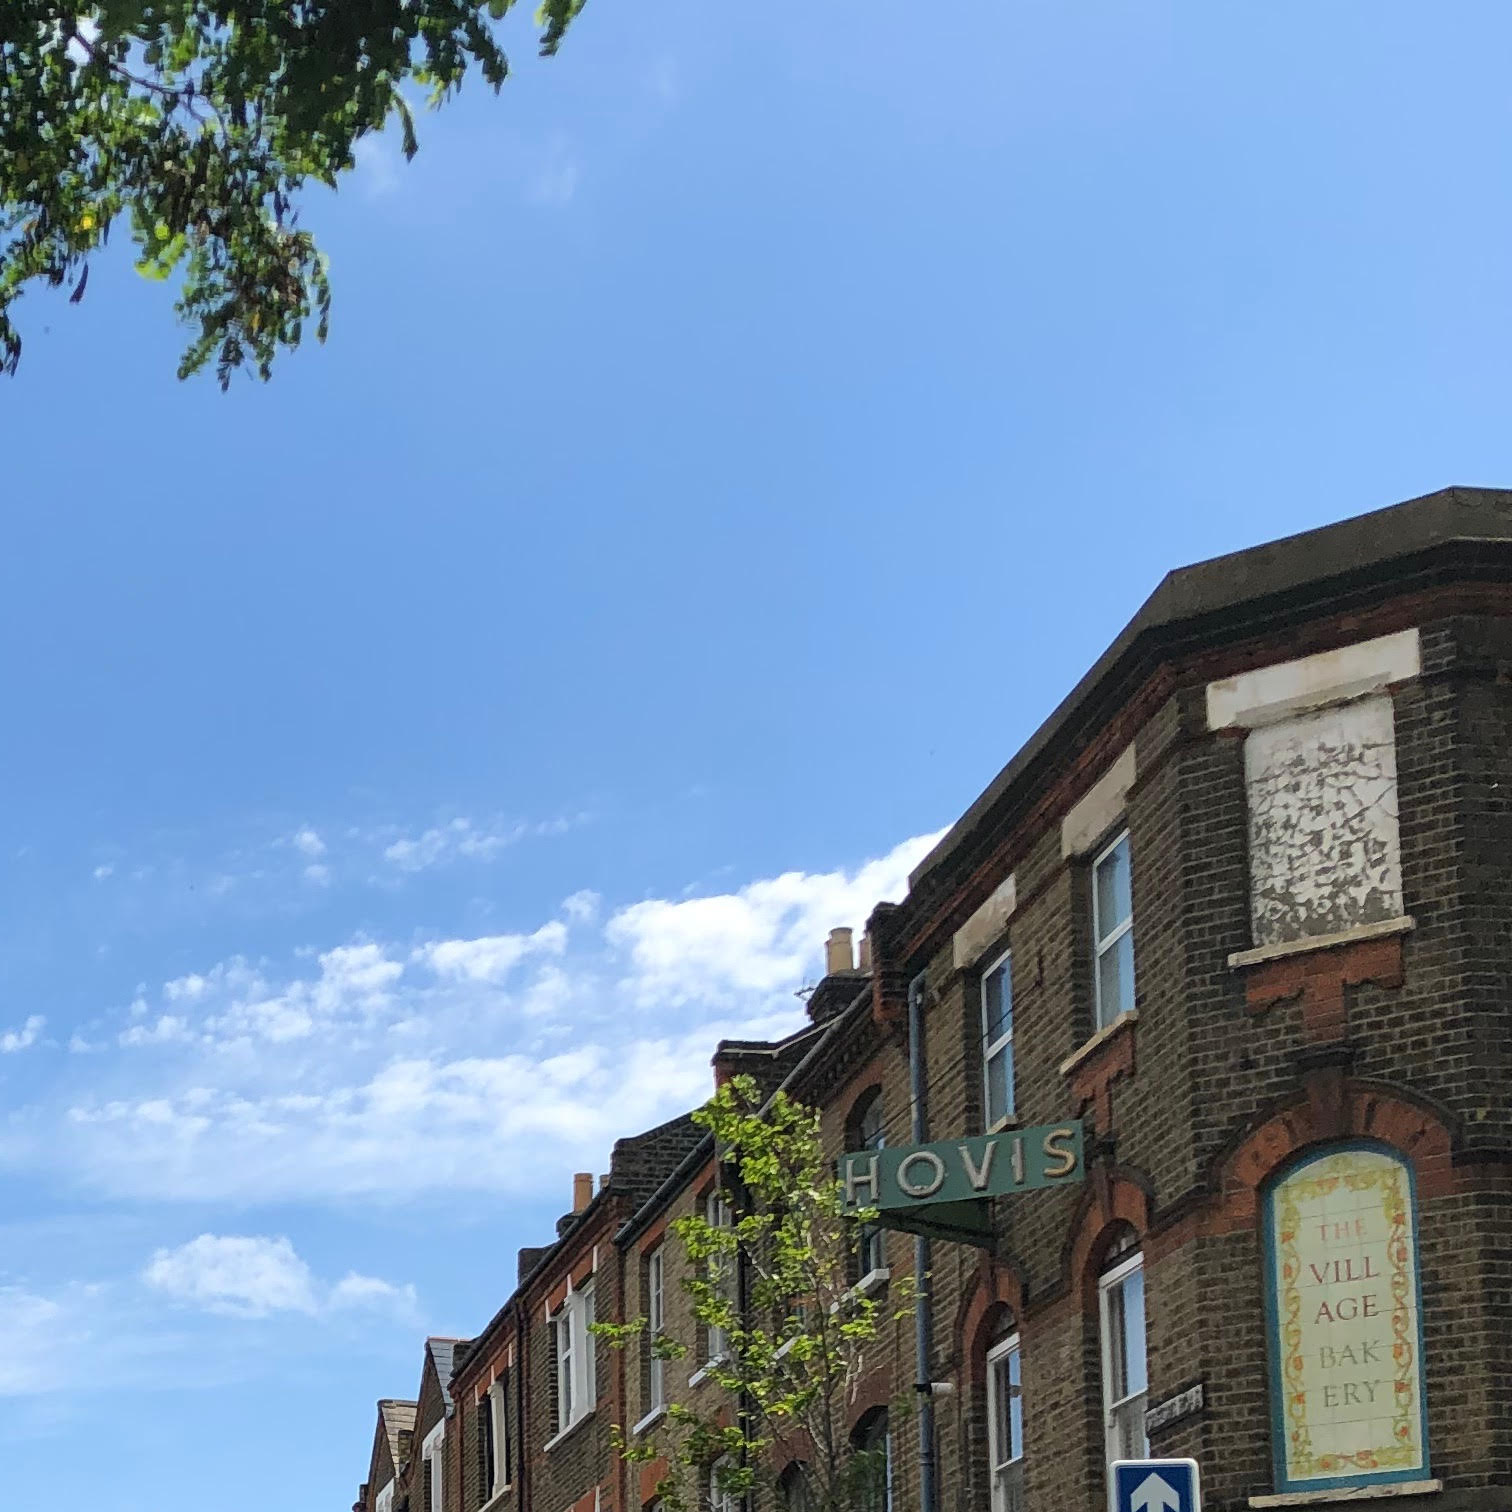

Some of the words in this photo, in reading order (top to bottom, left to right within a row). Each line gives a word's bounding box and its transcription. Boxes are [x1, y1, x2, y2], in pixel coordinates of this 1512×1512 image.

[846, 1128, 1077, 1206] HOVIS
[1315, 1219, 1367, 1240] THE
[1309, 1257, 1381, 1284] VILL
[1314, 1295, 1379, 1324] AGE
[1320, 1340, 1381, 1369] BAK
[1323, 1380, 1380, 1408] ERY
